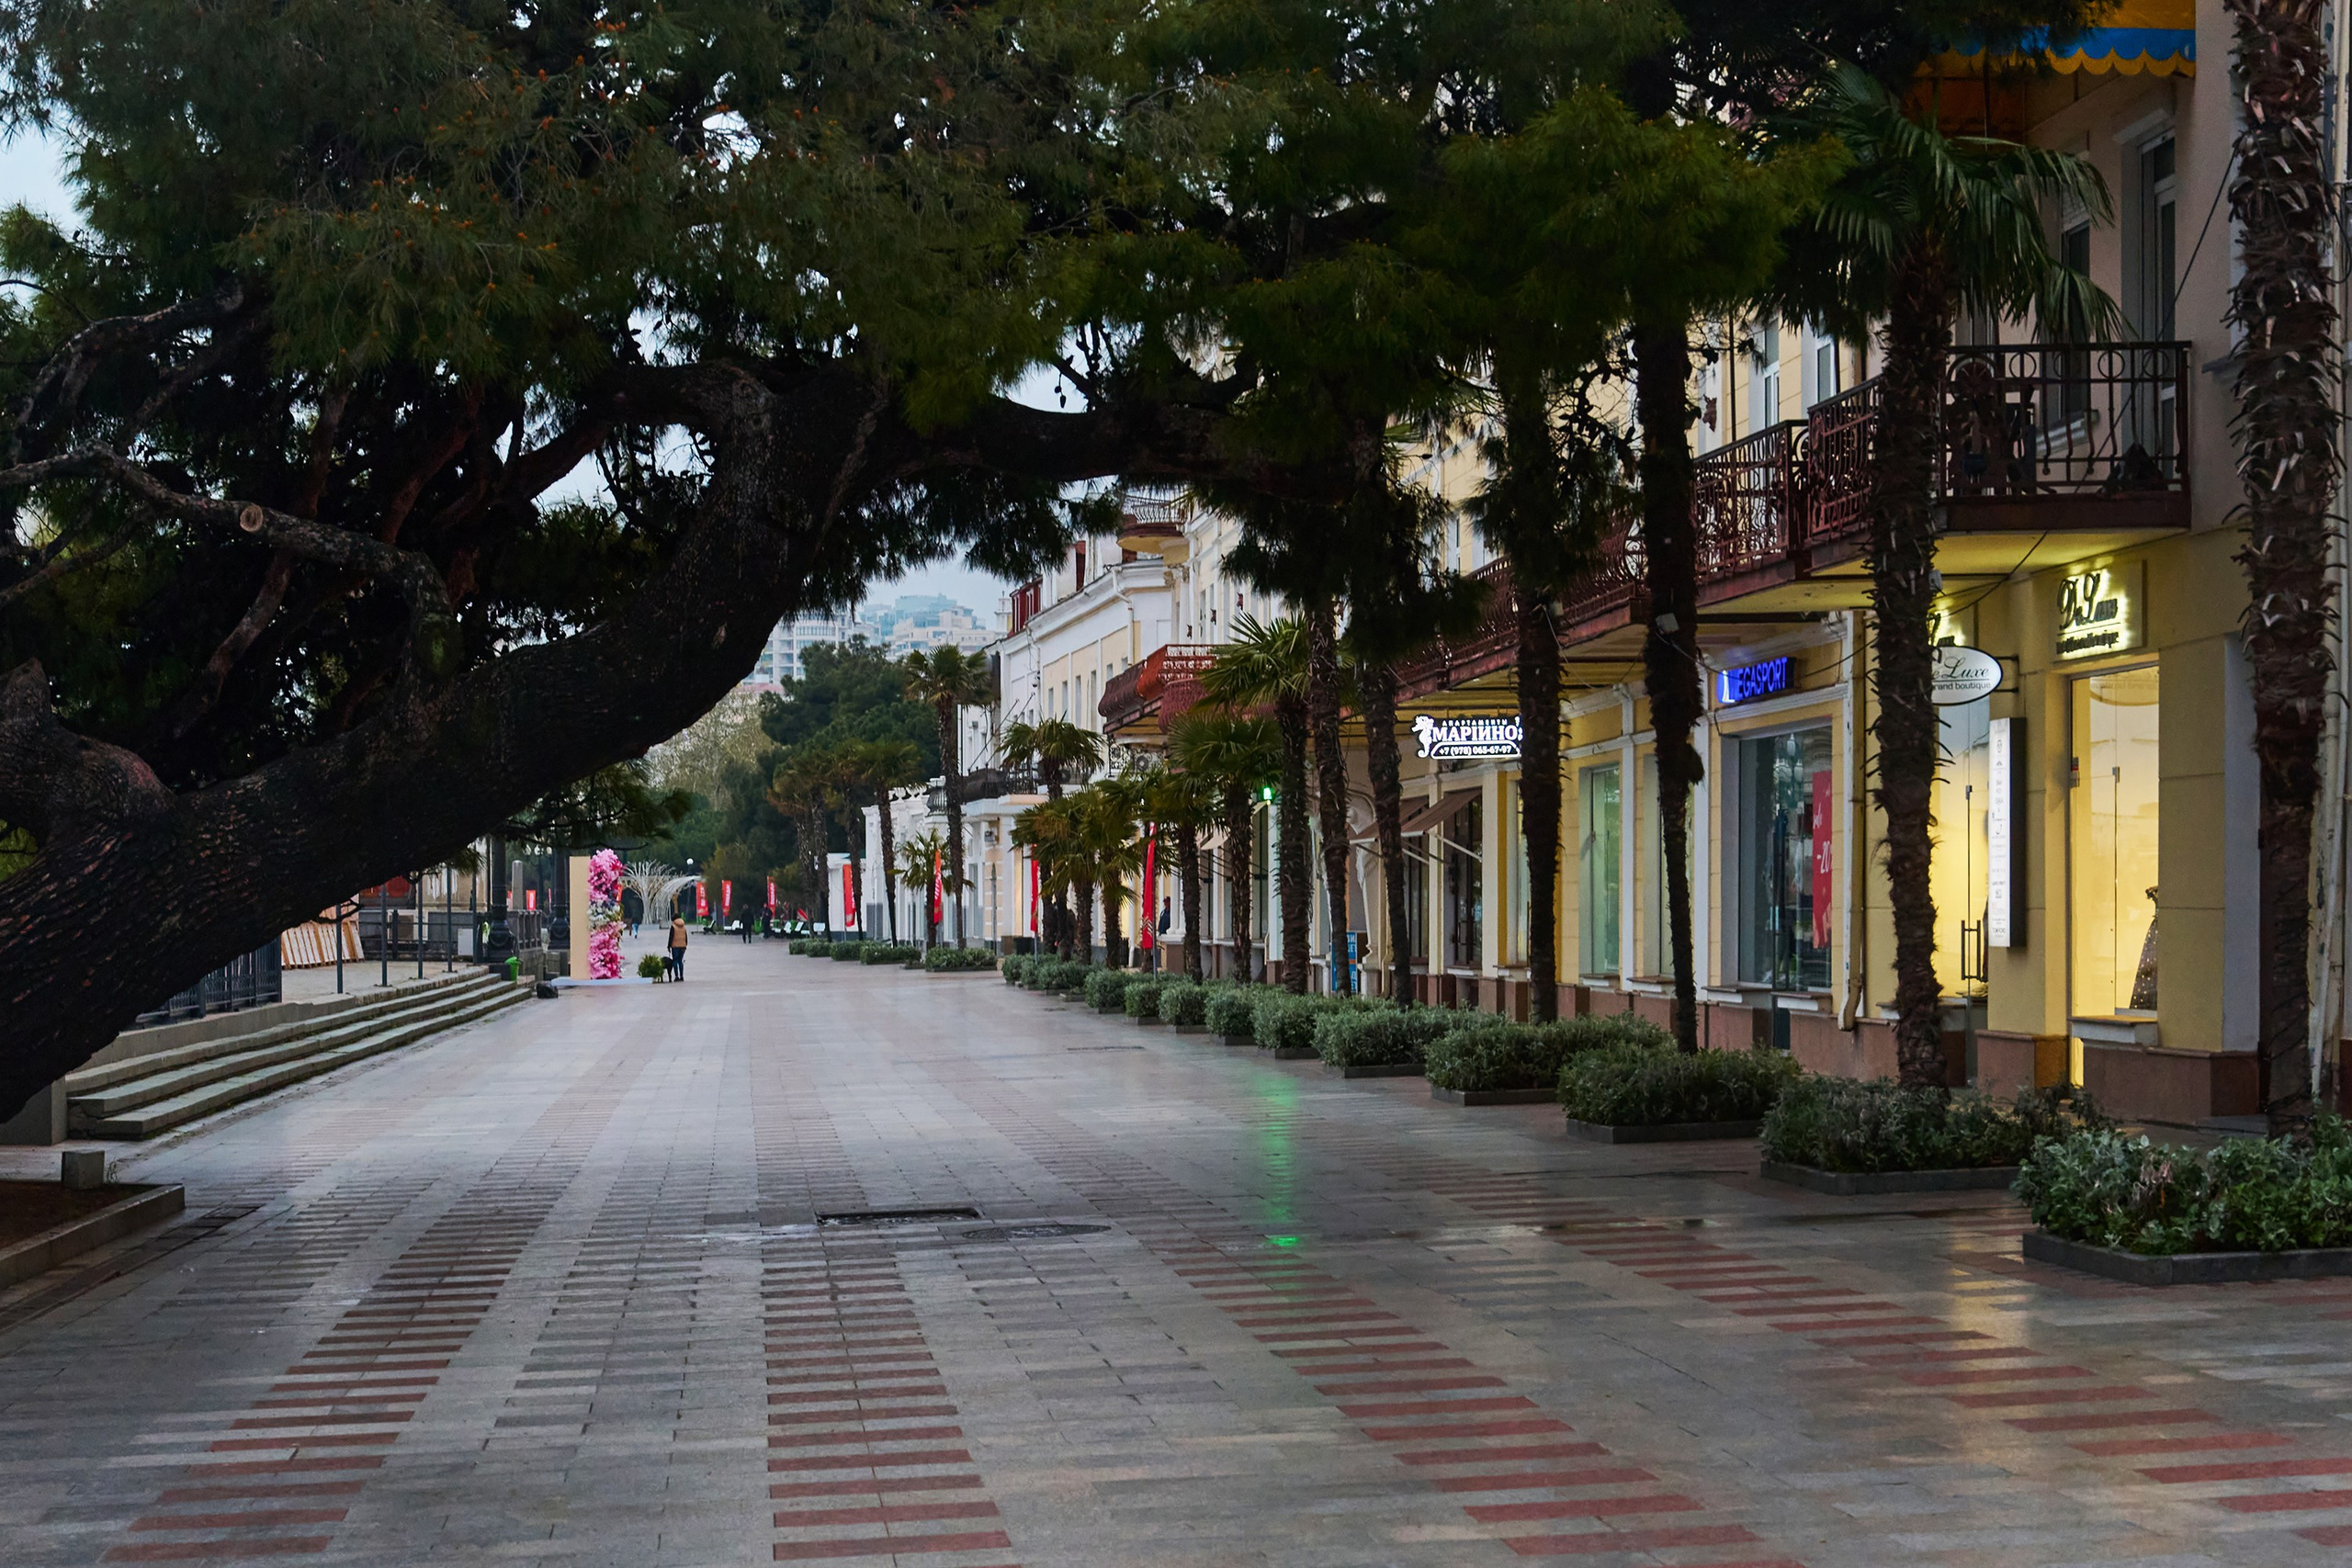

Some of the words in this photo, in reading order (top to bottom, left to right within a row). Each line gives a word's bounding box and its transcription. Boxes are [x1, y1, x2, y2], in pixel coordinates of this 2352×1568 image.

[1940, 656, 1989, 679] Luxe
[1932, 682, 1953, 691] rand
[1955, 682, 1991, 691] boutique
[1439, 746, 1450, 756] +7
[1450, 745, 1472, 757] (978)
[1816, 840, 1832, 874] -20
